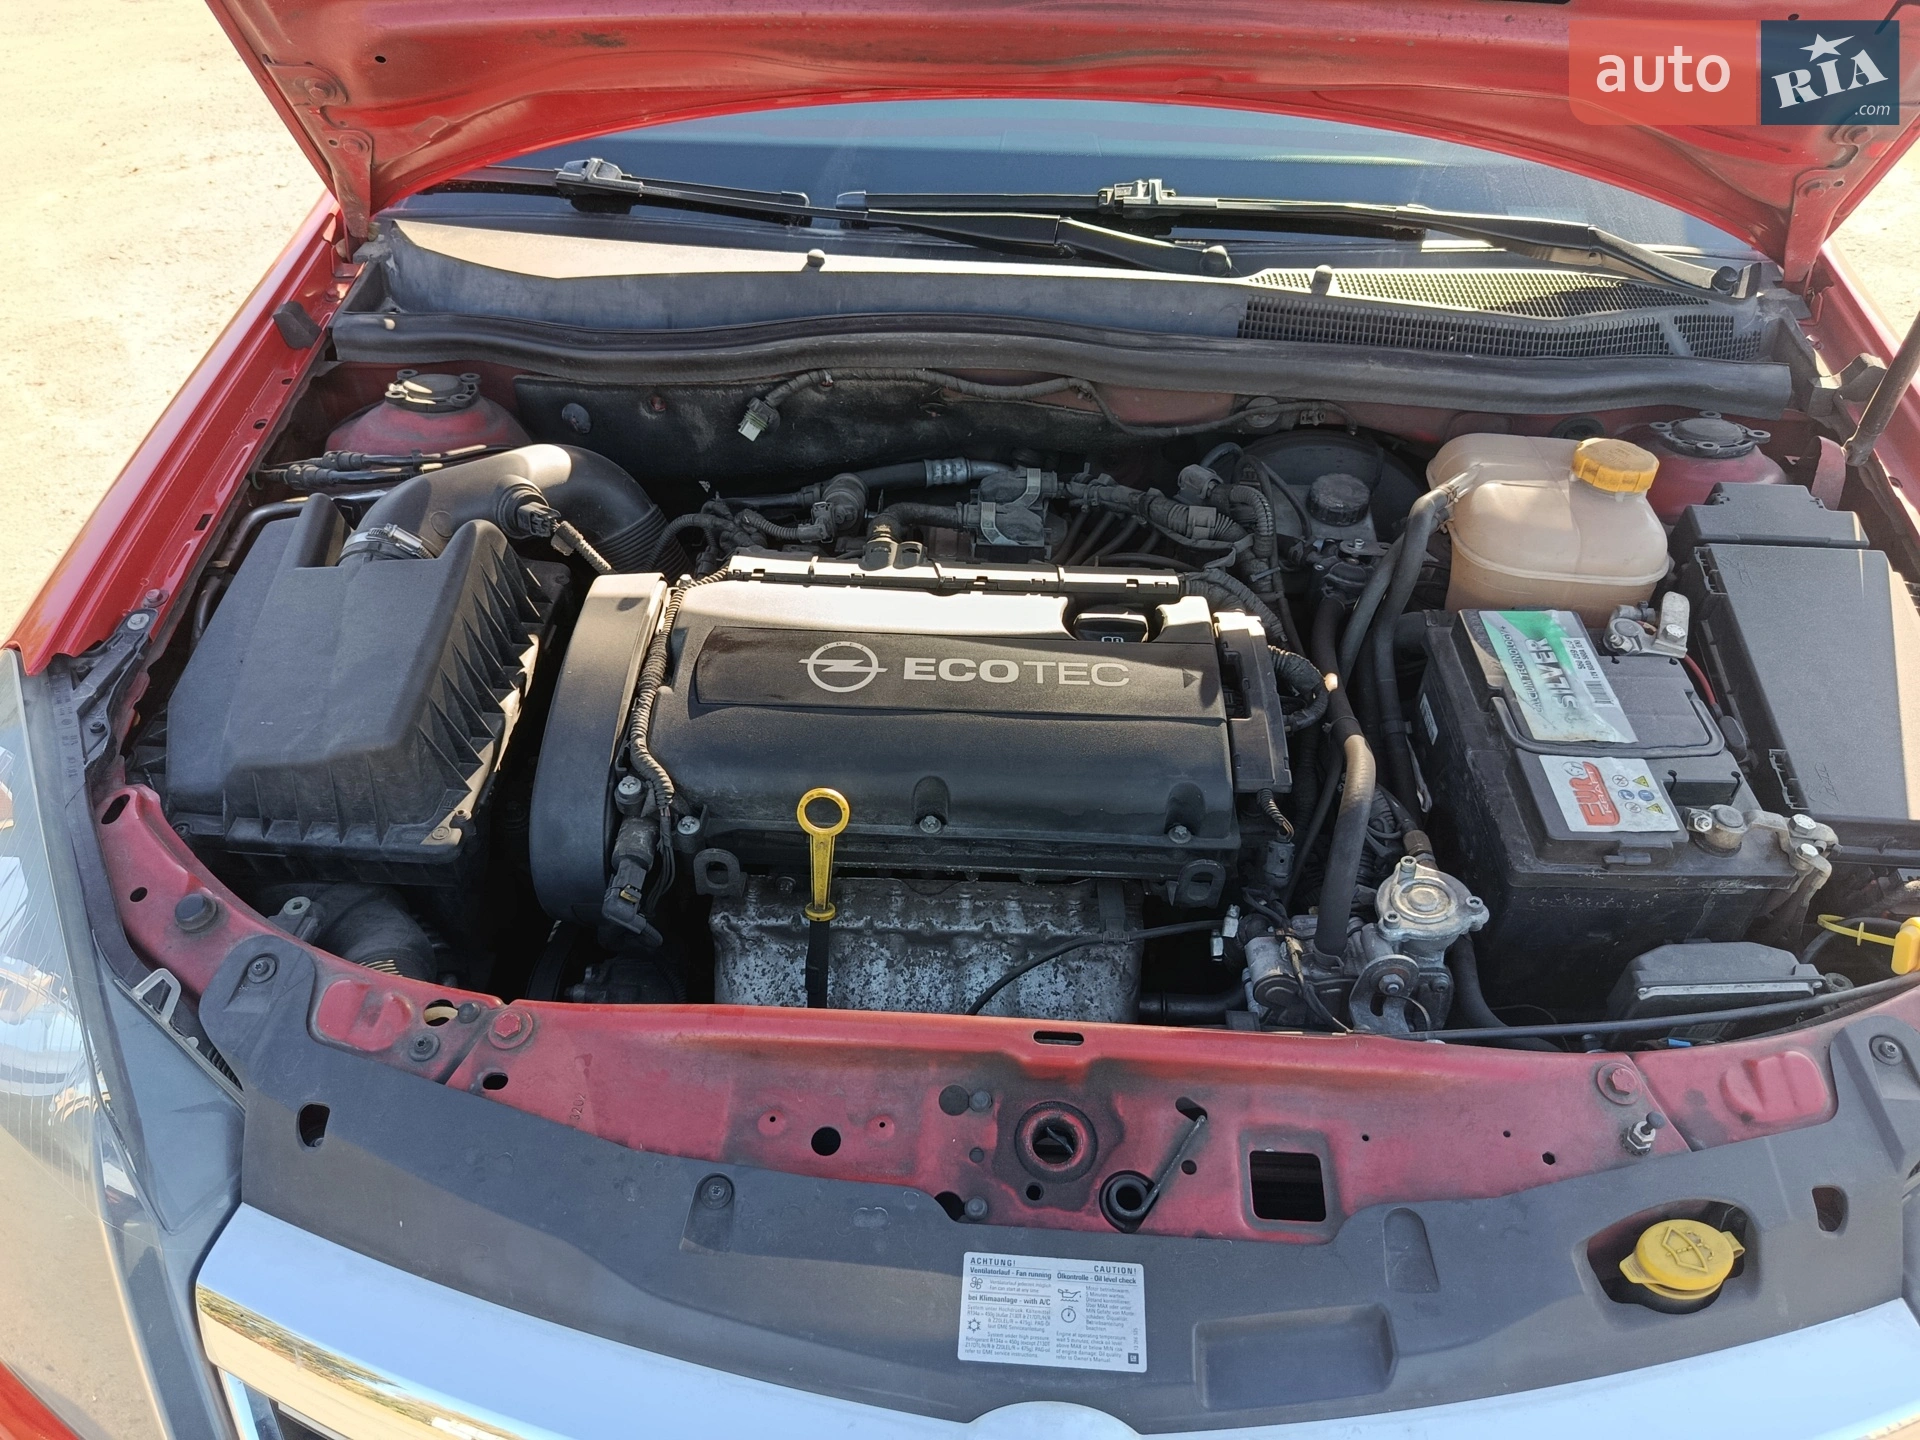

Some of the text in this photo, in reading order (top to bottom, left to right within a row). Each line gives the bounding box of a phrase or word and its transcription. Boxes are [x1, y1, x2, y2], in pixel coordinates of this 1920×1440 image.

[902, 657, 1130, 687] ECOTEC
[1525, 637, 1580, 709] SILVER
[1587, 768, 1613, 814] KRAFT
[970, 1257, 1016, 1267] ACHTUNG!
[970, 1267, 1010, 1275] Ventilatorlauf
[1028, 1271, 1052, 1280] running
[1094, 1265, 1137, 1275] CAUTION!
[1104, 1275, 1117, 1283] level
[1119, 1276, 1136, 1284] check
[979, 1295, 1018, 1305] Klimaanlage
